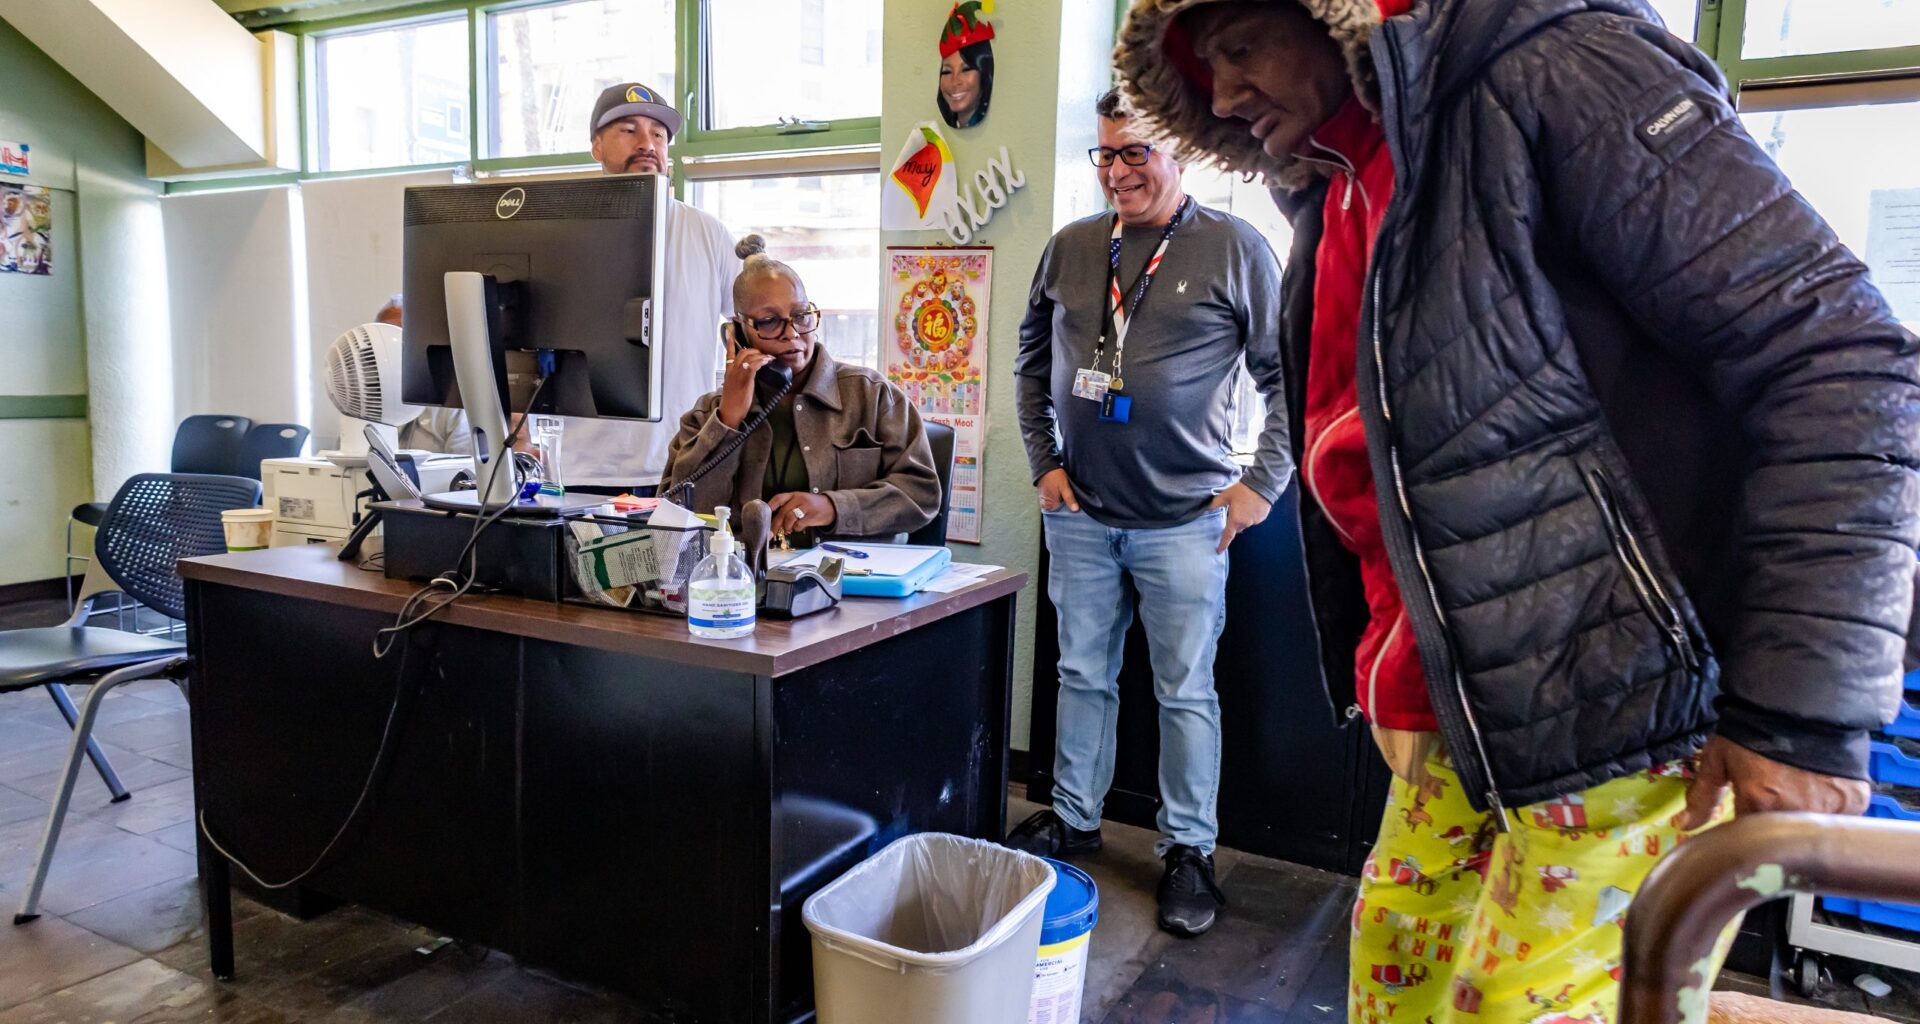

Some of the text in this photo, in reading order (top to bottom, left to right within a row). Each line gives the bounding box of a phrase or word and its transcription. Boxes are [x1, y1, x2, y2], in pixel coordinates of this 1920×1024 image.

[499, 198, 520, 207] DELL
[923, 312, 947, 338] 福
[954, 418, 974, 428] Meat
